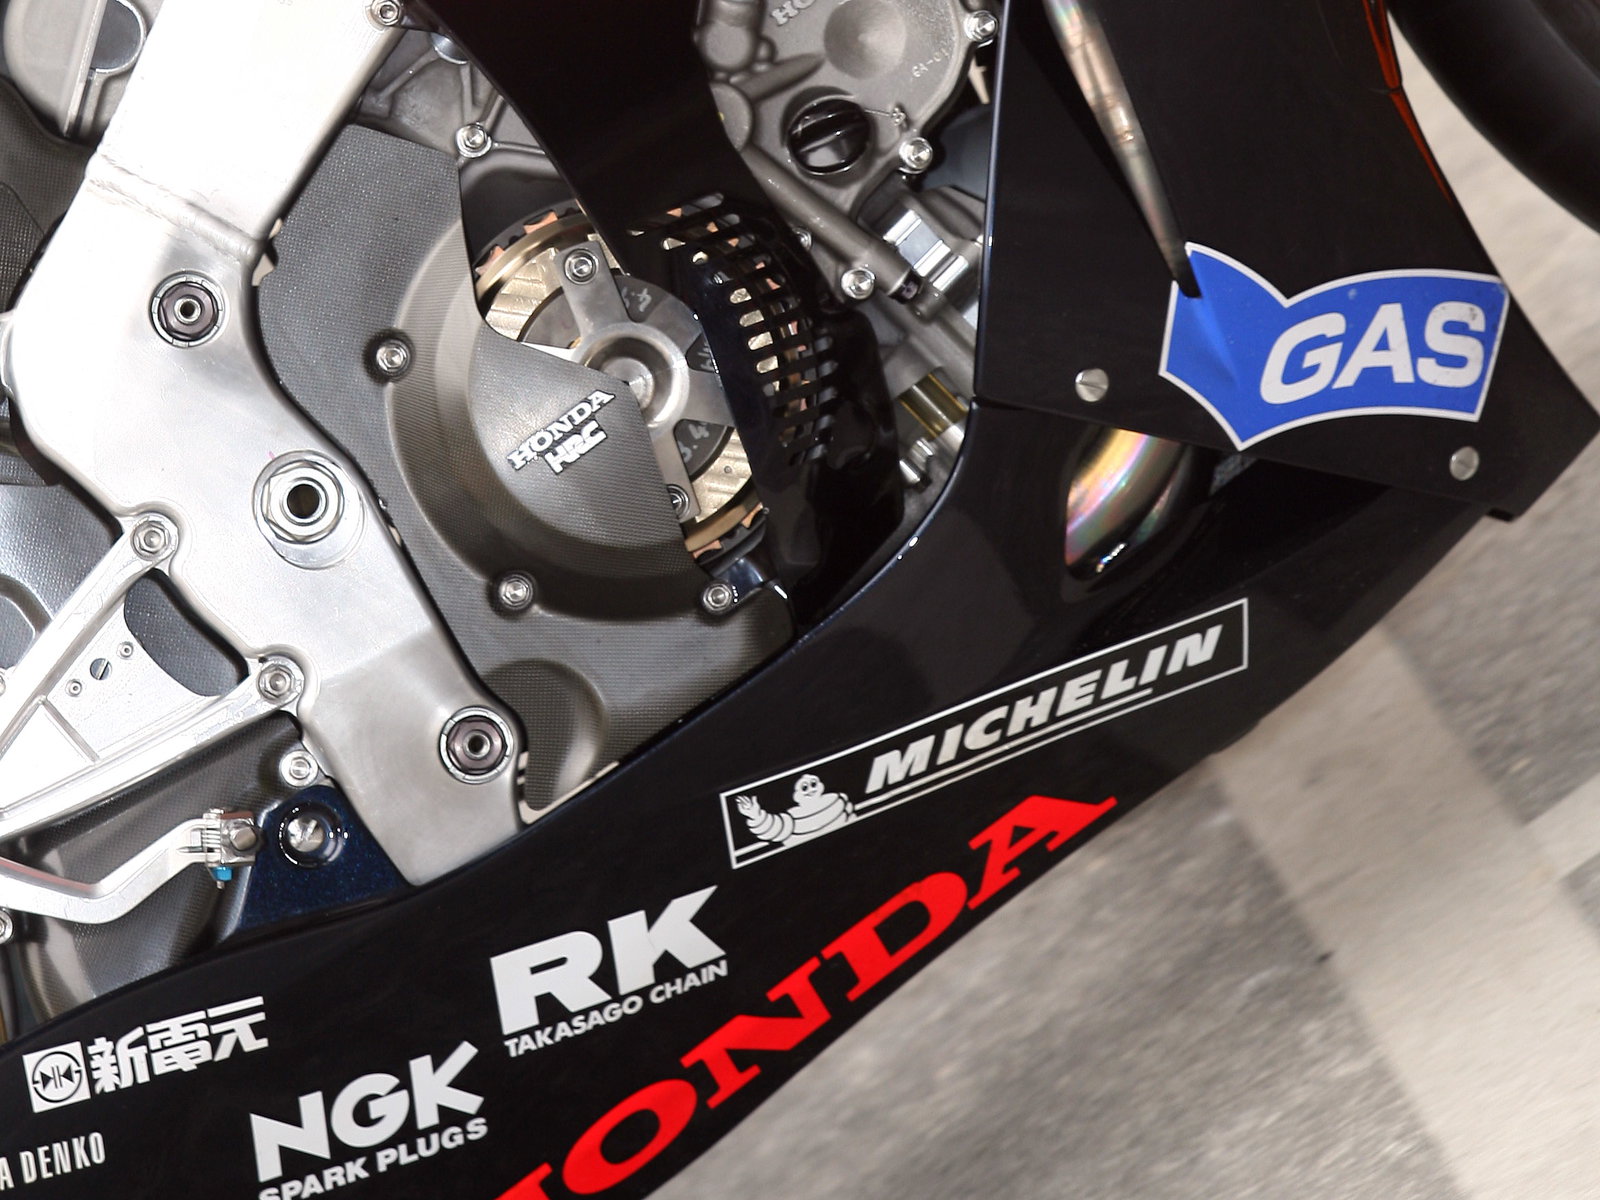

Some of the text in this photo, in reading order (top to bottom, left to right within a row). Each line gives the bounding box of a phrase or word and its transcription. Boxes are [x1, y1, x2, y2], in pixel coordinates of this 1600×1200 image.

[1259, 301, 1487, 406] GAS
[506, 389, 616, 471] HONDA
[543, 419, 608, 475] HRC
[864, 624, 1223, 795] MICHELIN
[489, 884, 727, 1036] RK
[504, 959, 728, 1058] TAKASAGO CHAIN
[87, 995, 269, 1095] 新電元
[19, 1131, 106, 1185] DENKO
[249, 1040, 485, 1183] NGK
[376, 1117, 489, 1173] PLUGS
